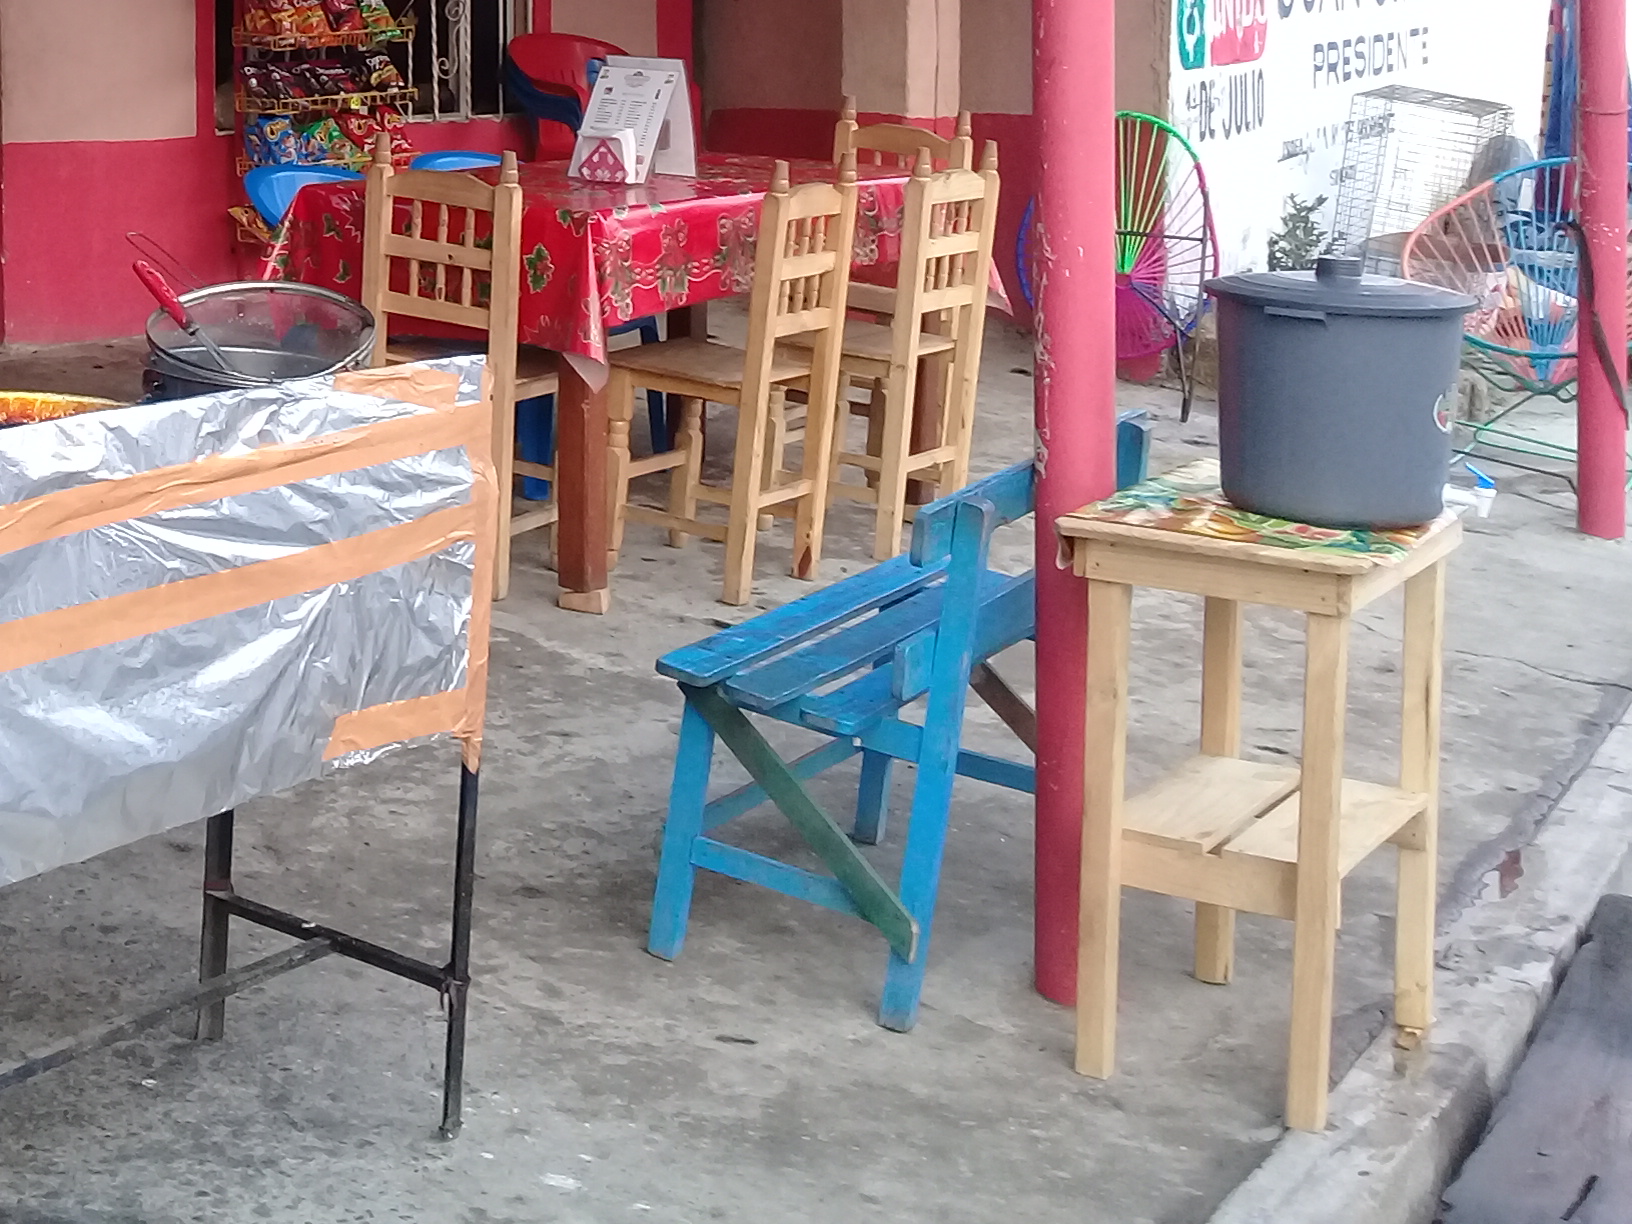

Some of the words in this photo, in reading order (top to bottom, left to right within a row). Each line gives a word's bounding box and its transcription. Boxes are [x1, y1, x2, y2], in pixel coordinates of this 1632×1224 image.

[1313, 26, 1429, 89] PRESIDENTE
[1199, 80, 1216, 143] DE
[1222, 67, 1265, 140] JULIO
